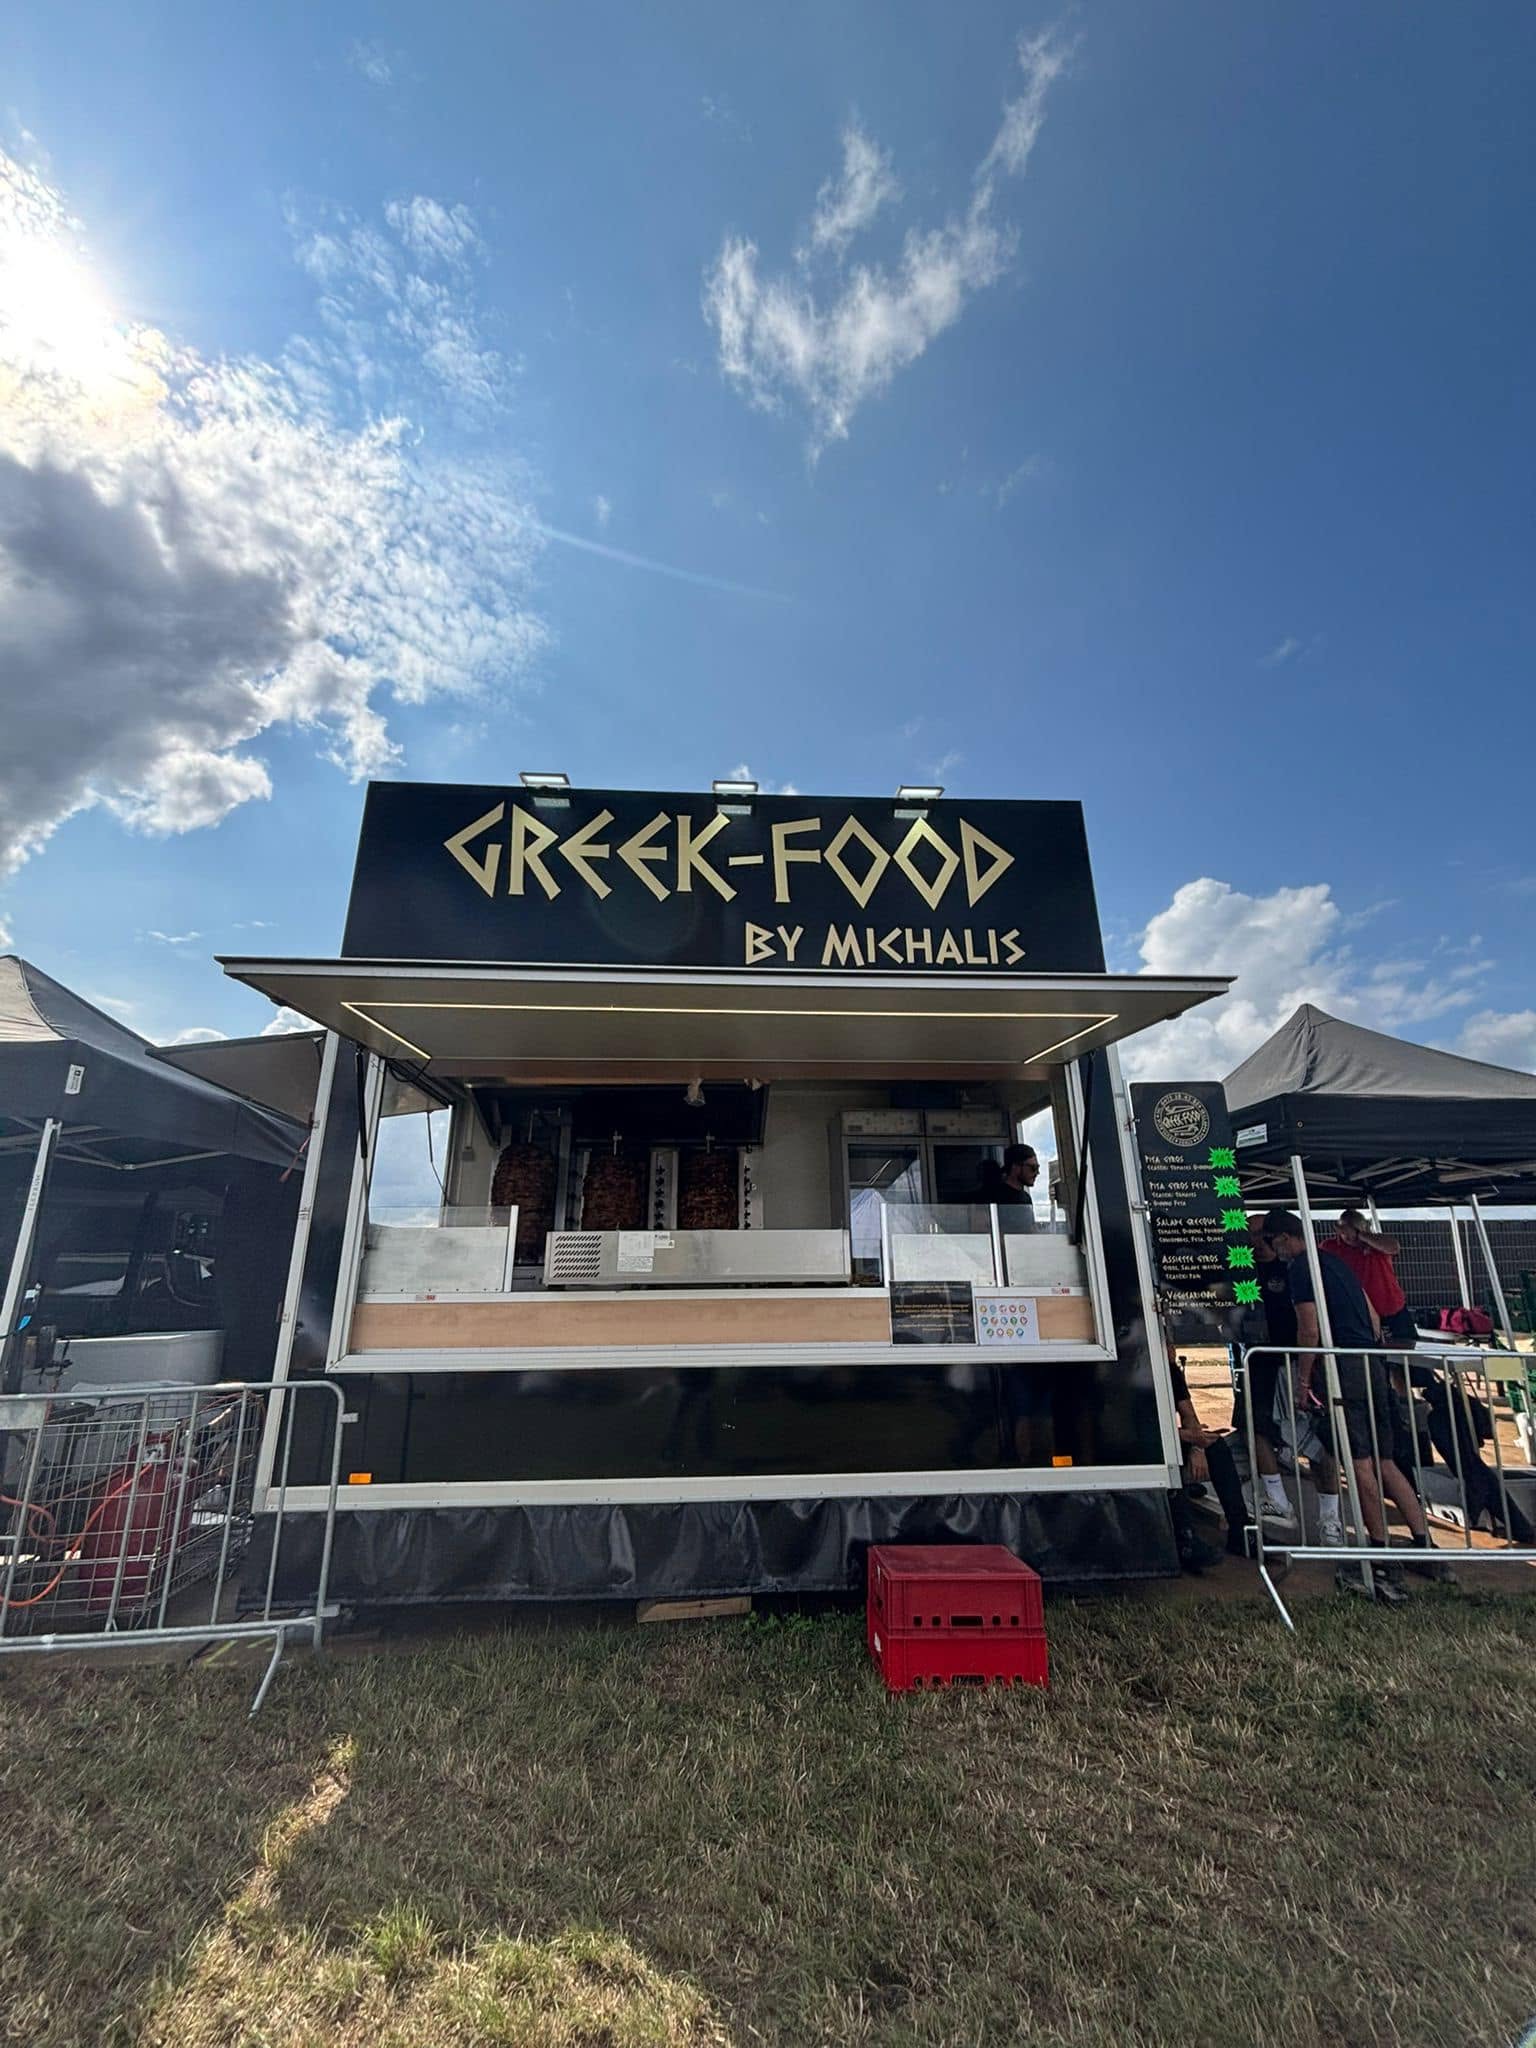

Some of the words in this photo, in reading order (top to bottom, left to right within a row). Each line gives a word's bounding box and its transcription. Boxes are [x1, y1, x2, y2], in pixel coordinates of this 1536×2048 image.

[442, 801, 1016, 910] GREEK-FOOD
[744, 921, 804, 966] BY
[820, 922, 1027, 967] MICHALIS
